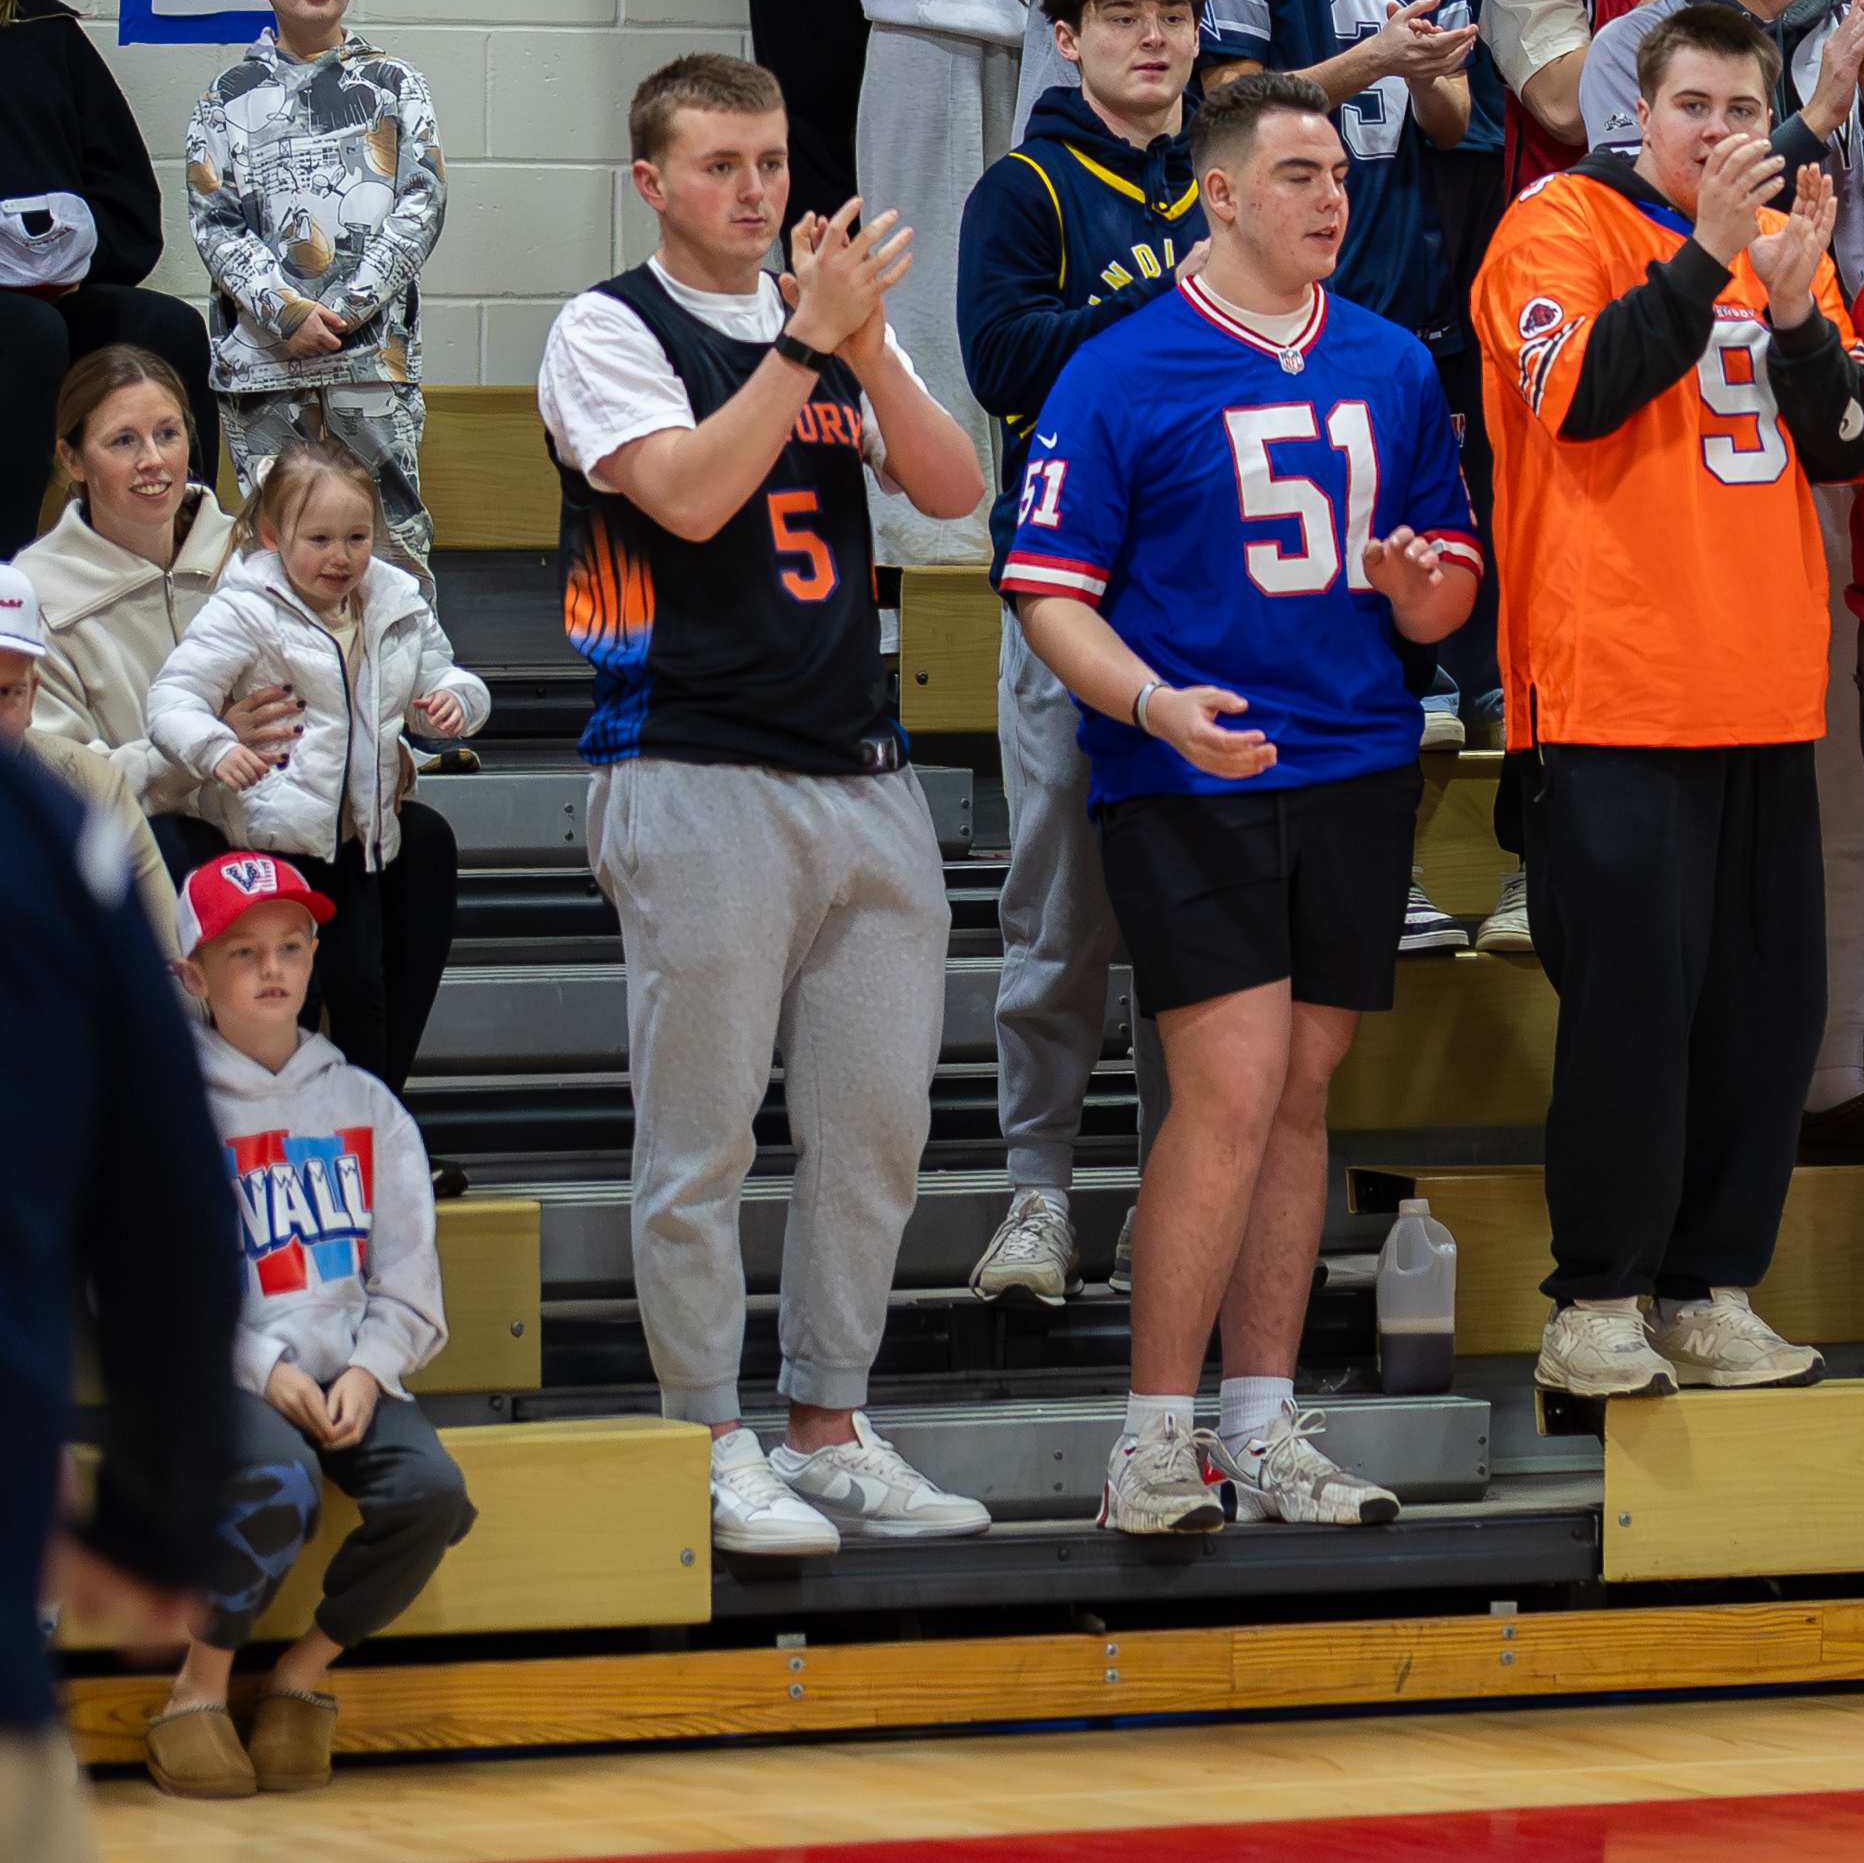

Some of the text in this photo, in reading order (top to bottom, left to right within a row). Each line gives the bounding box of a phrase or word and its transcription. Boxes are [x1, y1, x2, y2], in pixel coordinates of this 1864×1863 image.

[1698, 320, 1788, 485] 9
[766, 488, 840, 604] 5
[1223, 400, 1379, 597] 51
[222, 859, 278, 896] W
